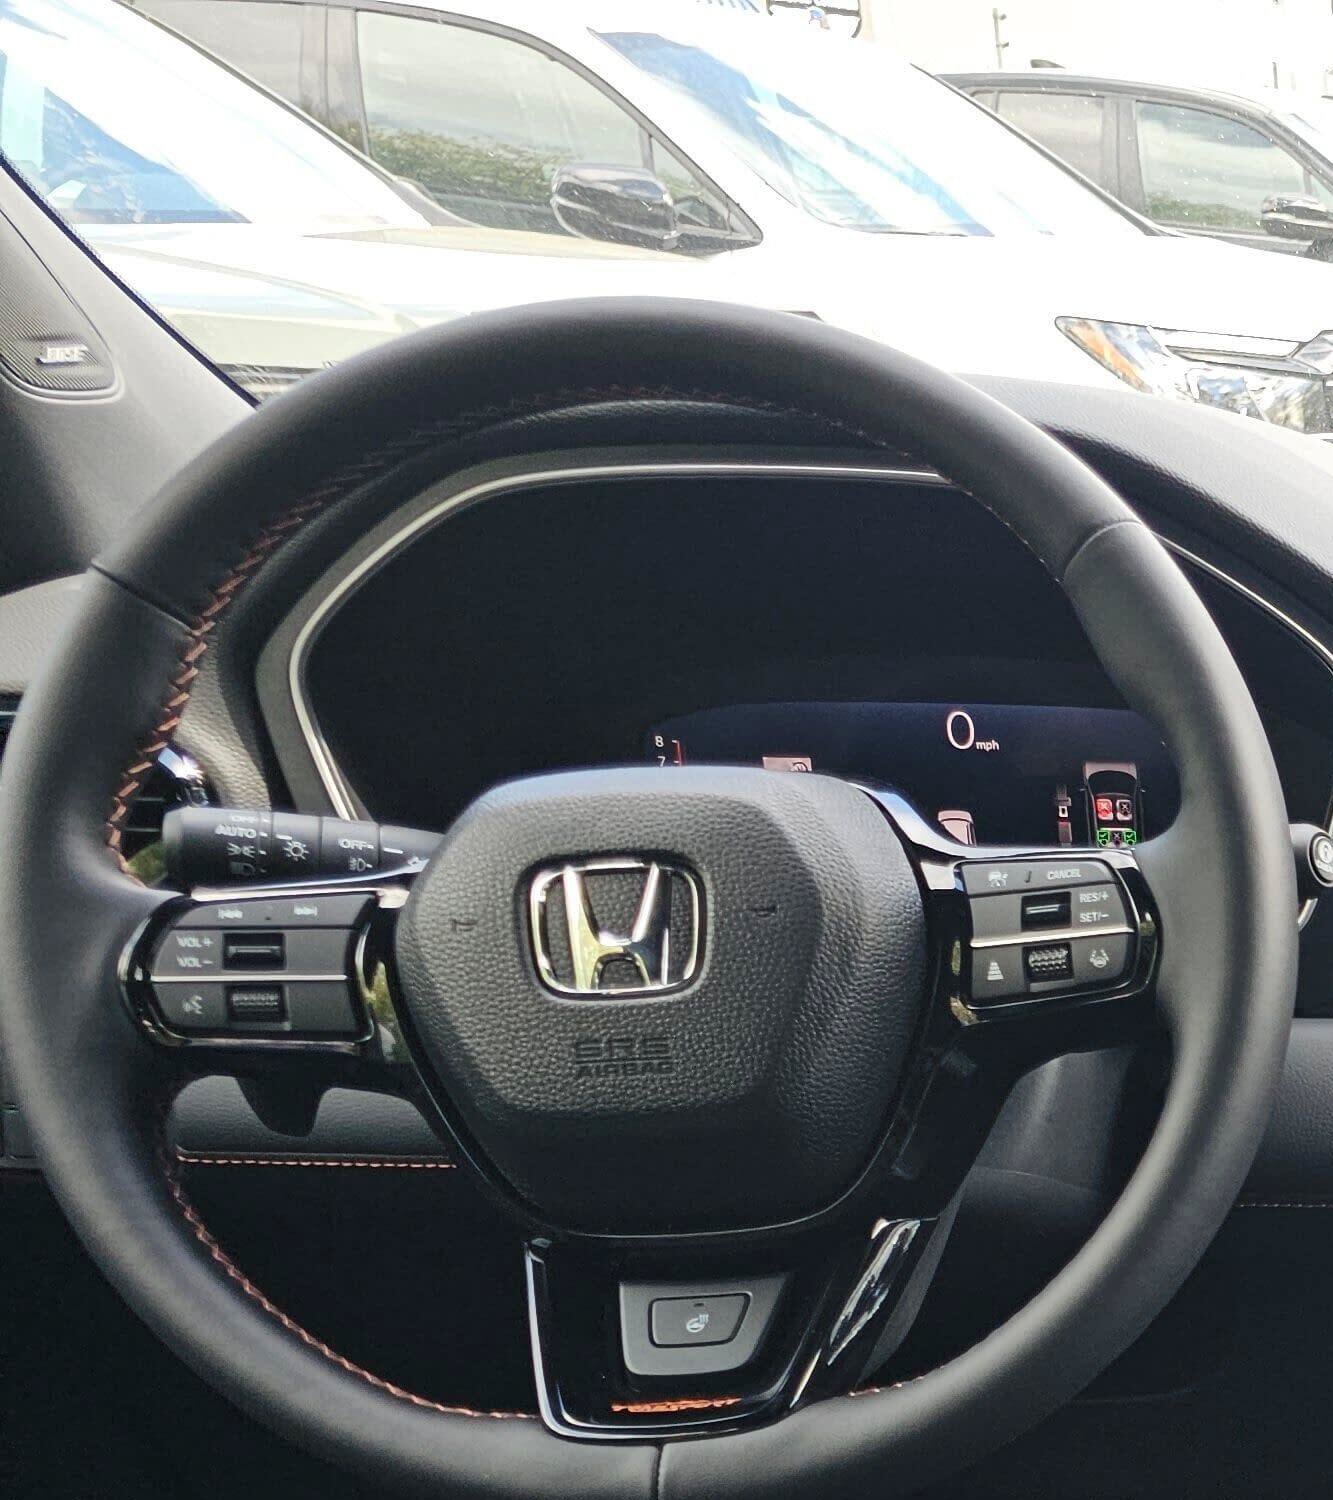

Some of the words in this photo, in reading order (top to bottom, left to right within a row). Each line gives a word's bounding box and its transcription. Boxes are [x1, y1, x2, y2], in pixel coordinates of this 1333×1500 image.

[655, 736, 664, 748] 8
[976, 740, 1000, 752] mph
[658, 756, 666, 768] 7
[214, 825, 257, 838] AUTO
[1046, 868, 1082, 880] CANCEL
